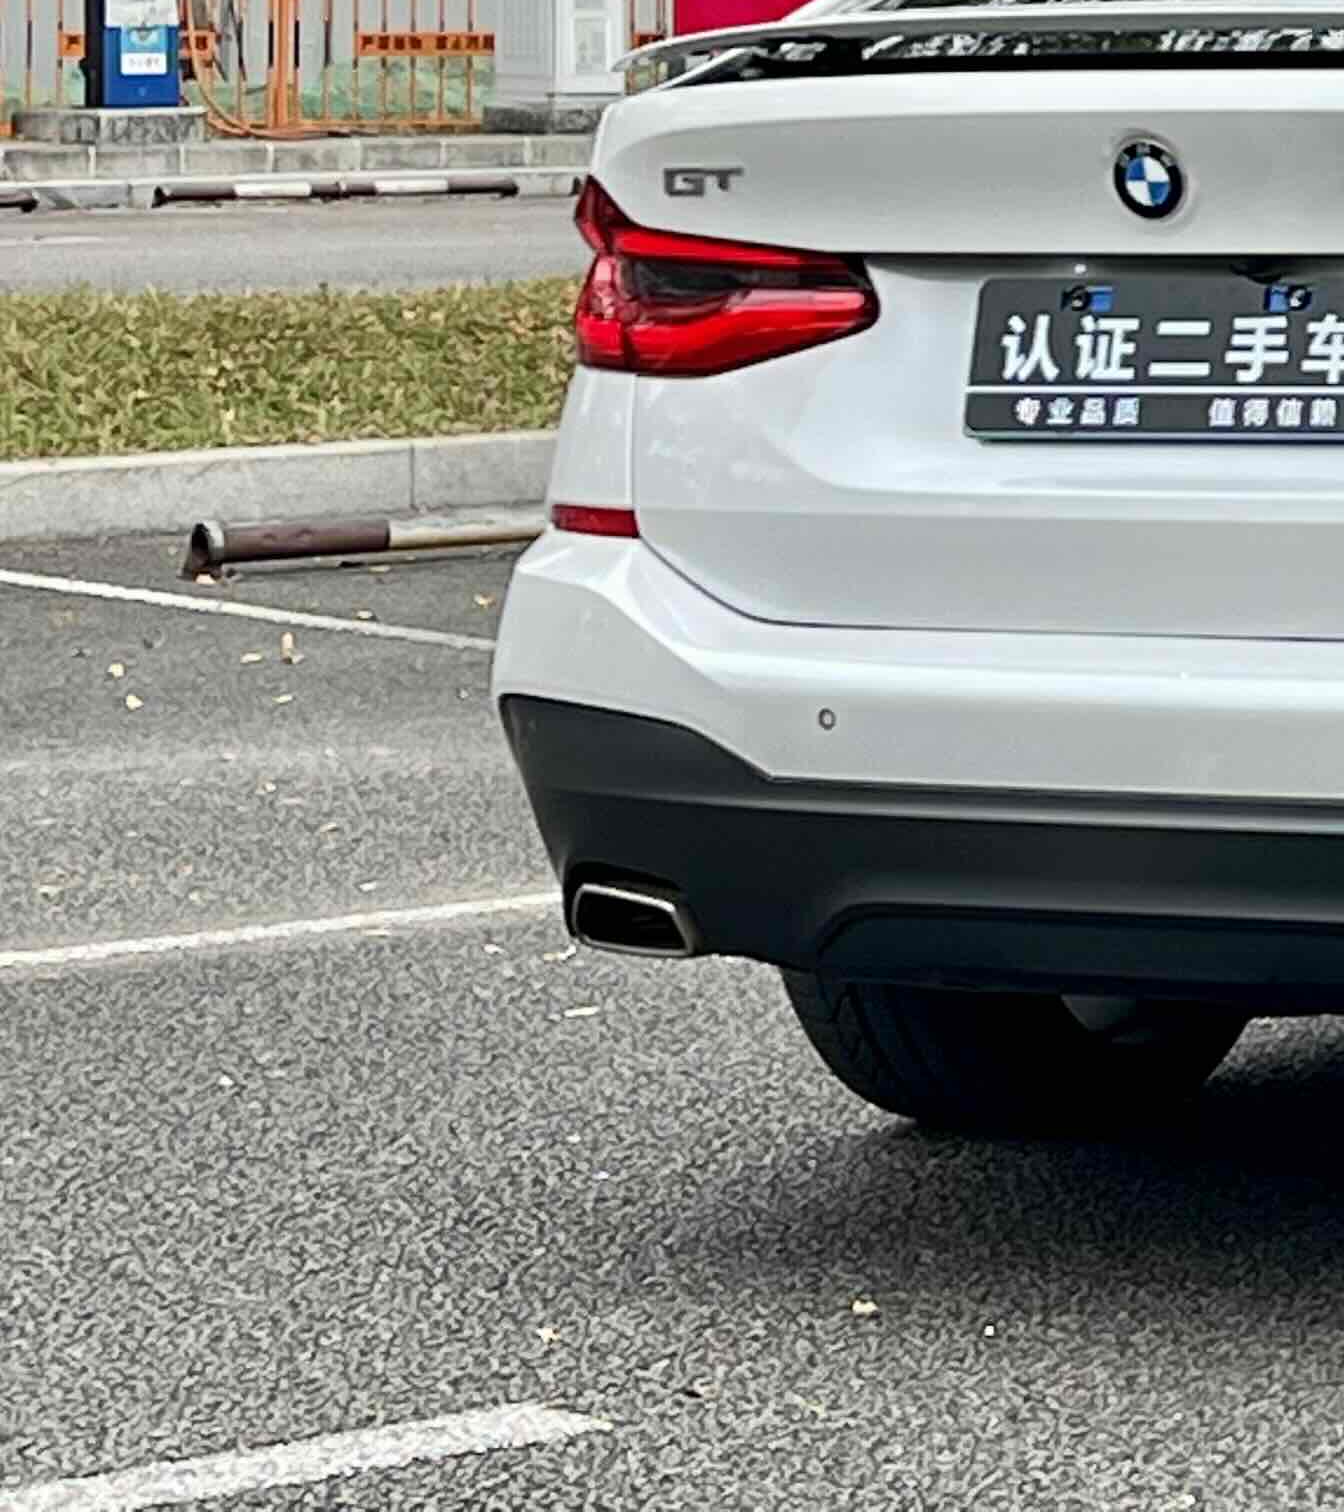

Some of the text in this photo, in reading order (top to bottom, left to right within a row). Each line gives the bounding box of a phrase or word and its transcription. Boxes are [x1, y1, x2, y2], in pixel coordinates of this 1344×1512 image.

[664, 167, 744, 197] GT
[1014, 397, 1140, 426] 专业品质
